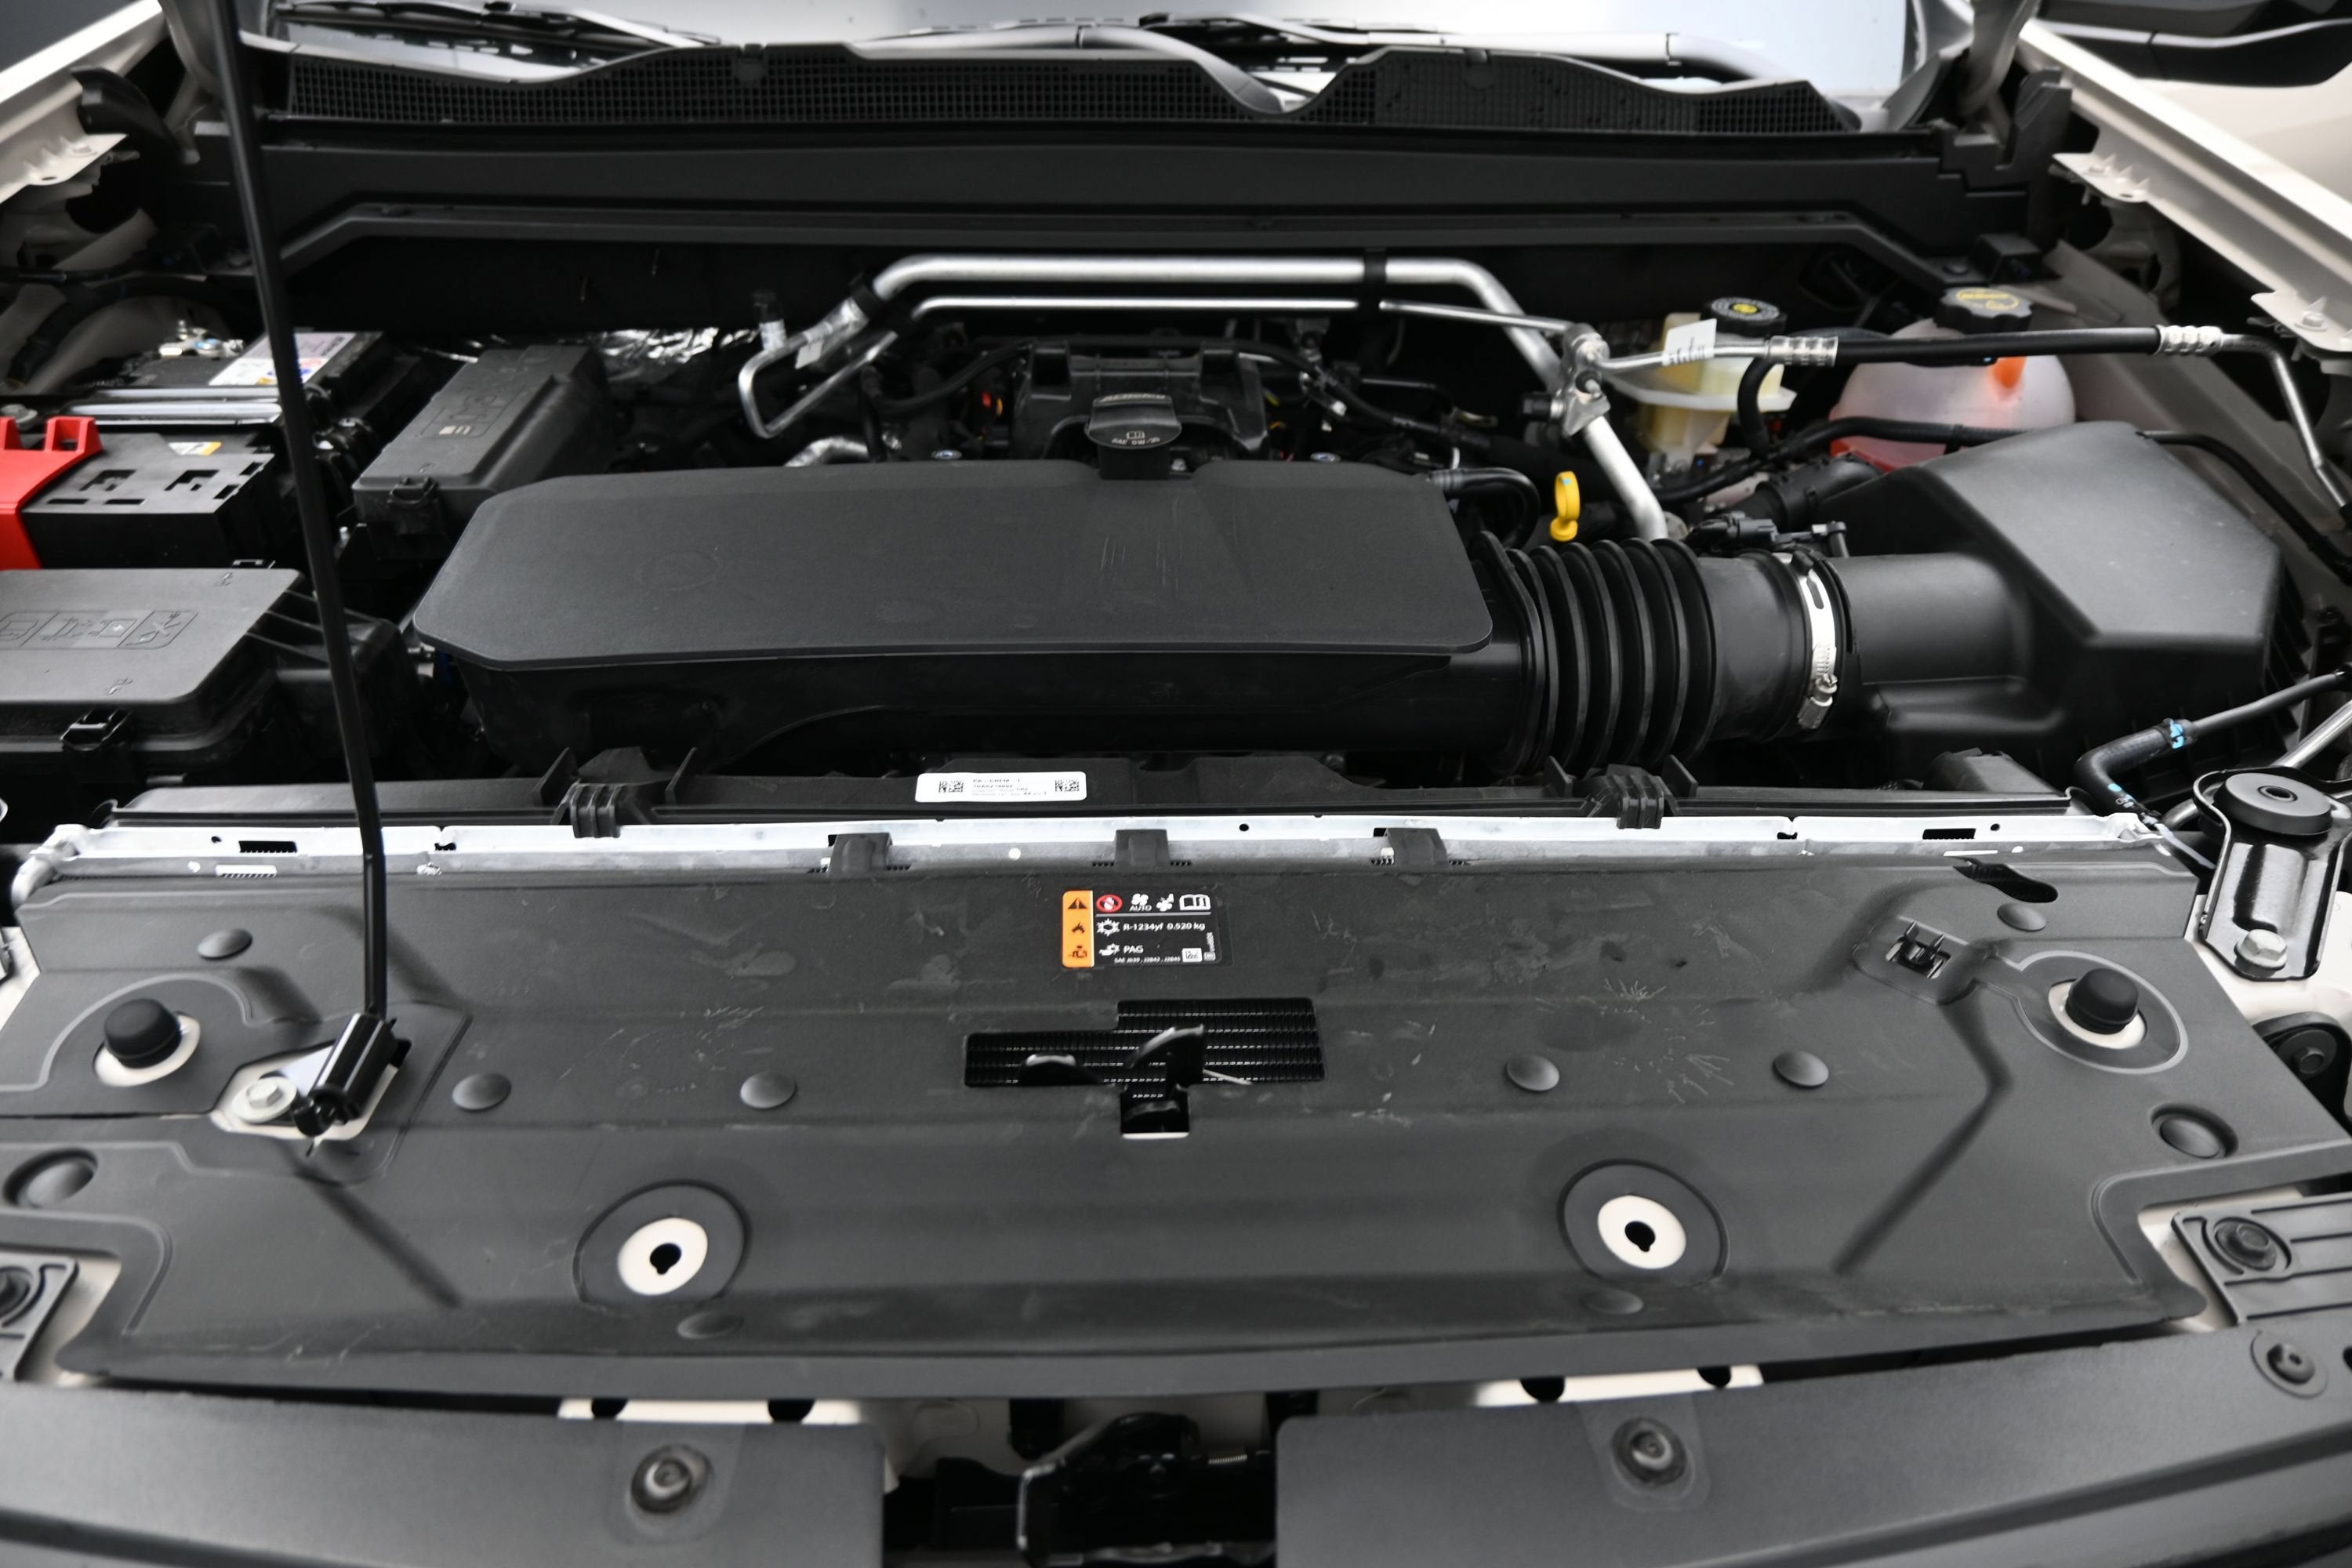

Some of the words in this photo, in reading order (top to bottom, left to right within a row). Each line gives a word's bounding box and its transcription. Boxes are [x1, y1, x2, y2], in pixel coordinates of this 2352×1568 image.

[1123, 922, 1164, 931] R-1234yf
[1167, 922, 1192, 931] 0.520
[1193, 922, 1206, 931] kg
[1123, 945, 1144, 953] PAG
